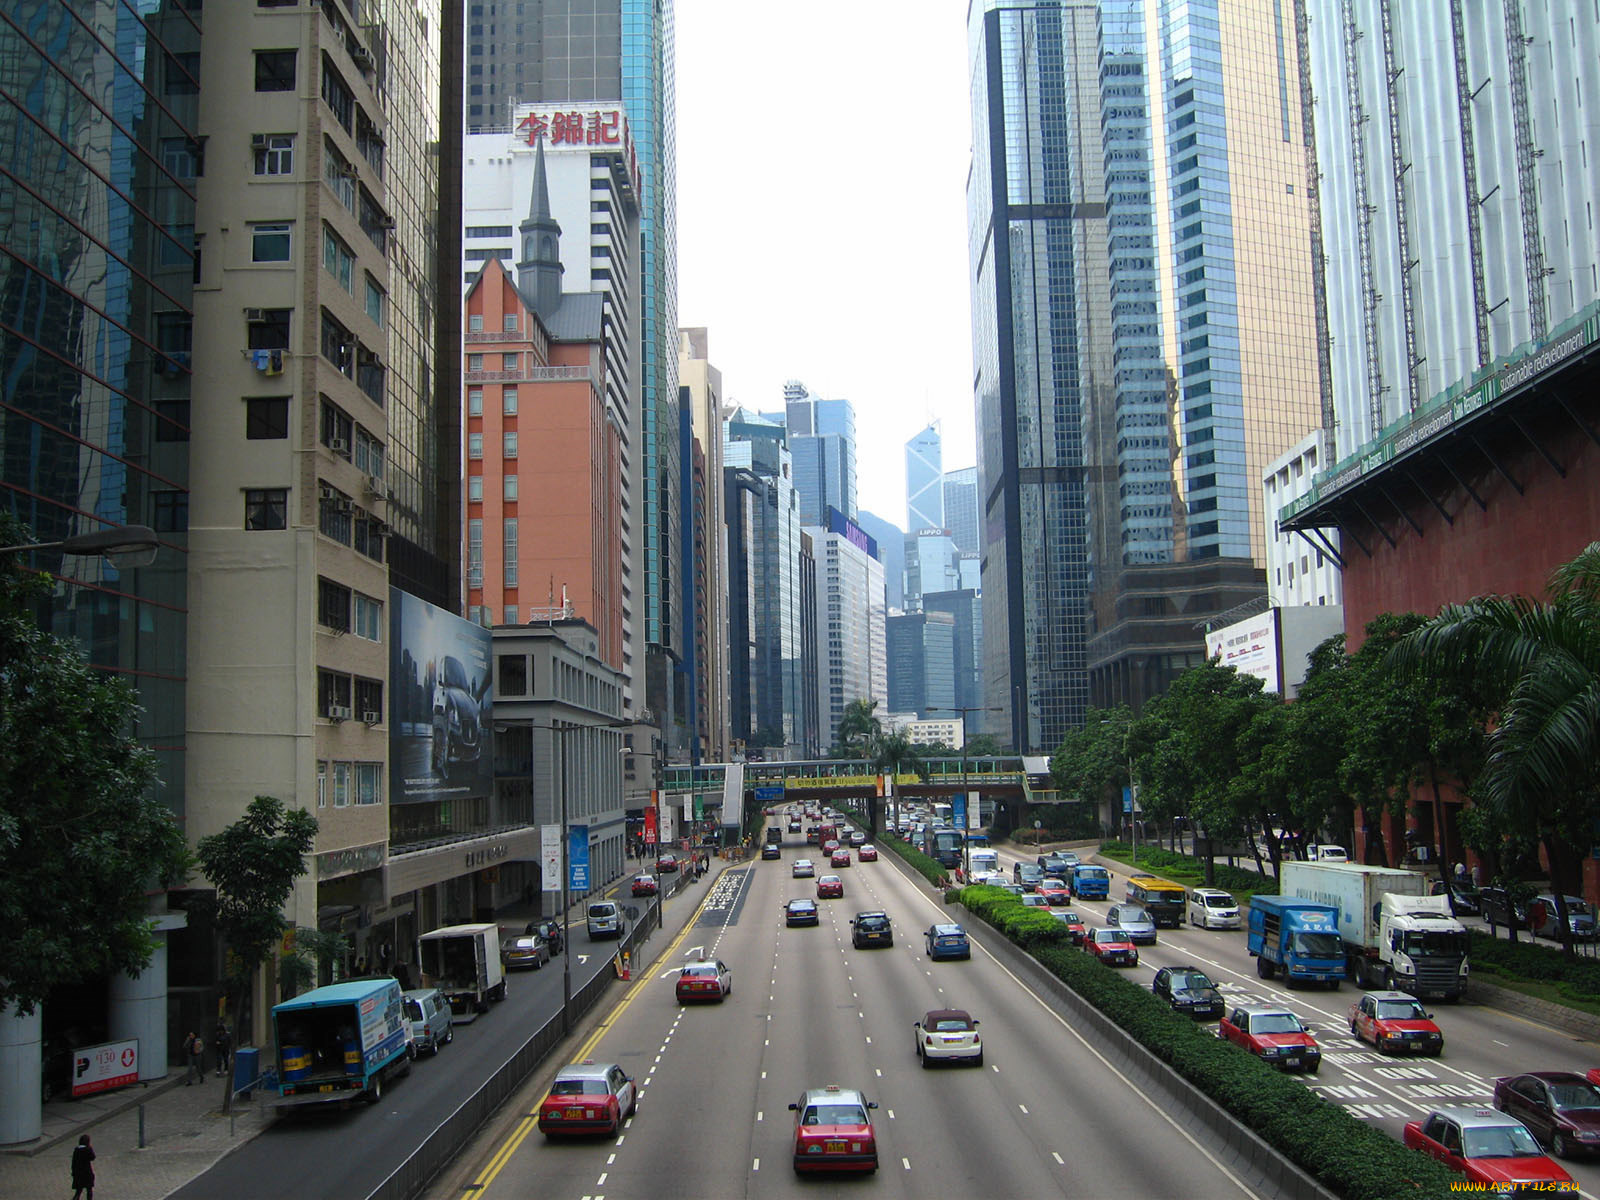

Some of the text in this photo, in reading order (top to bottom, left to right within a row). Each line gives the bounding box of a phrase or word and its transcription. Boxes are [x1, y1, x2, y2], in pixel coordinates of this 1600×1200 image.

[515, 111, 620, 146] 李錦記
[1500, 329, 1584, 393] sustainable redevelopment
[846, 521, 868, 553] SAMSUNG
[1373, 1067, 1438, 1079] AND
[1394, 1083, 1495, 1098] POINT
